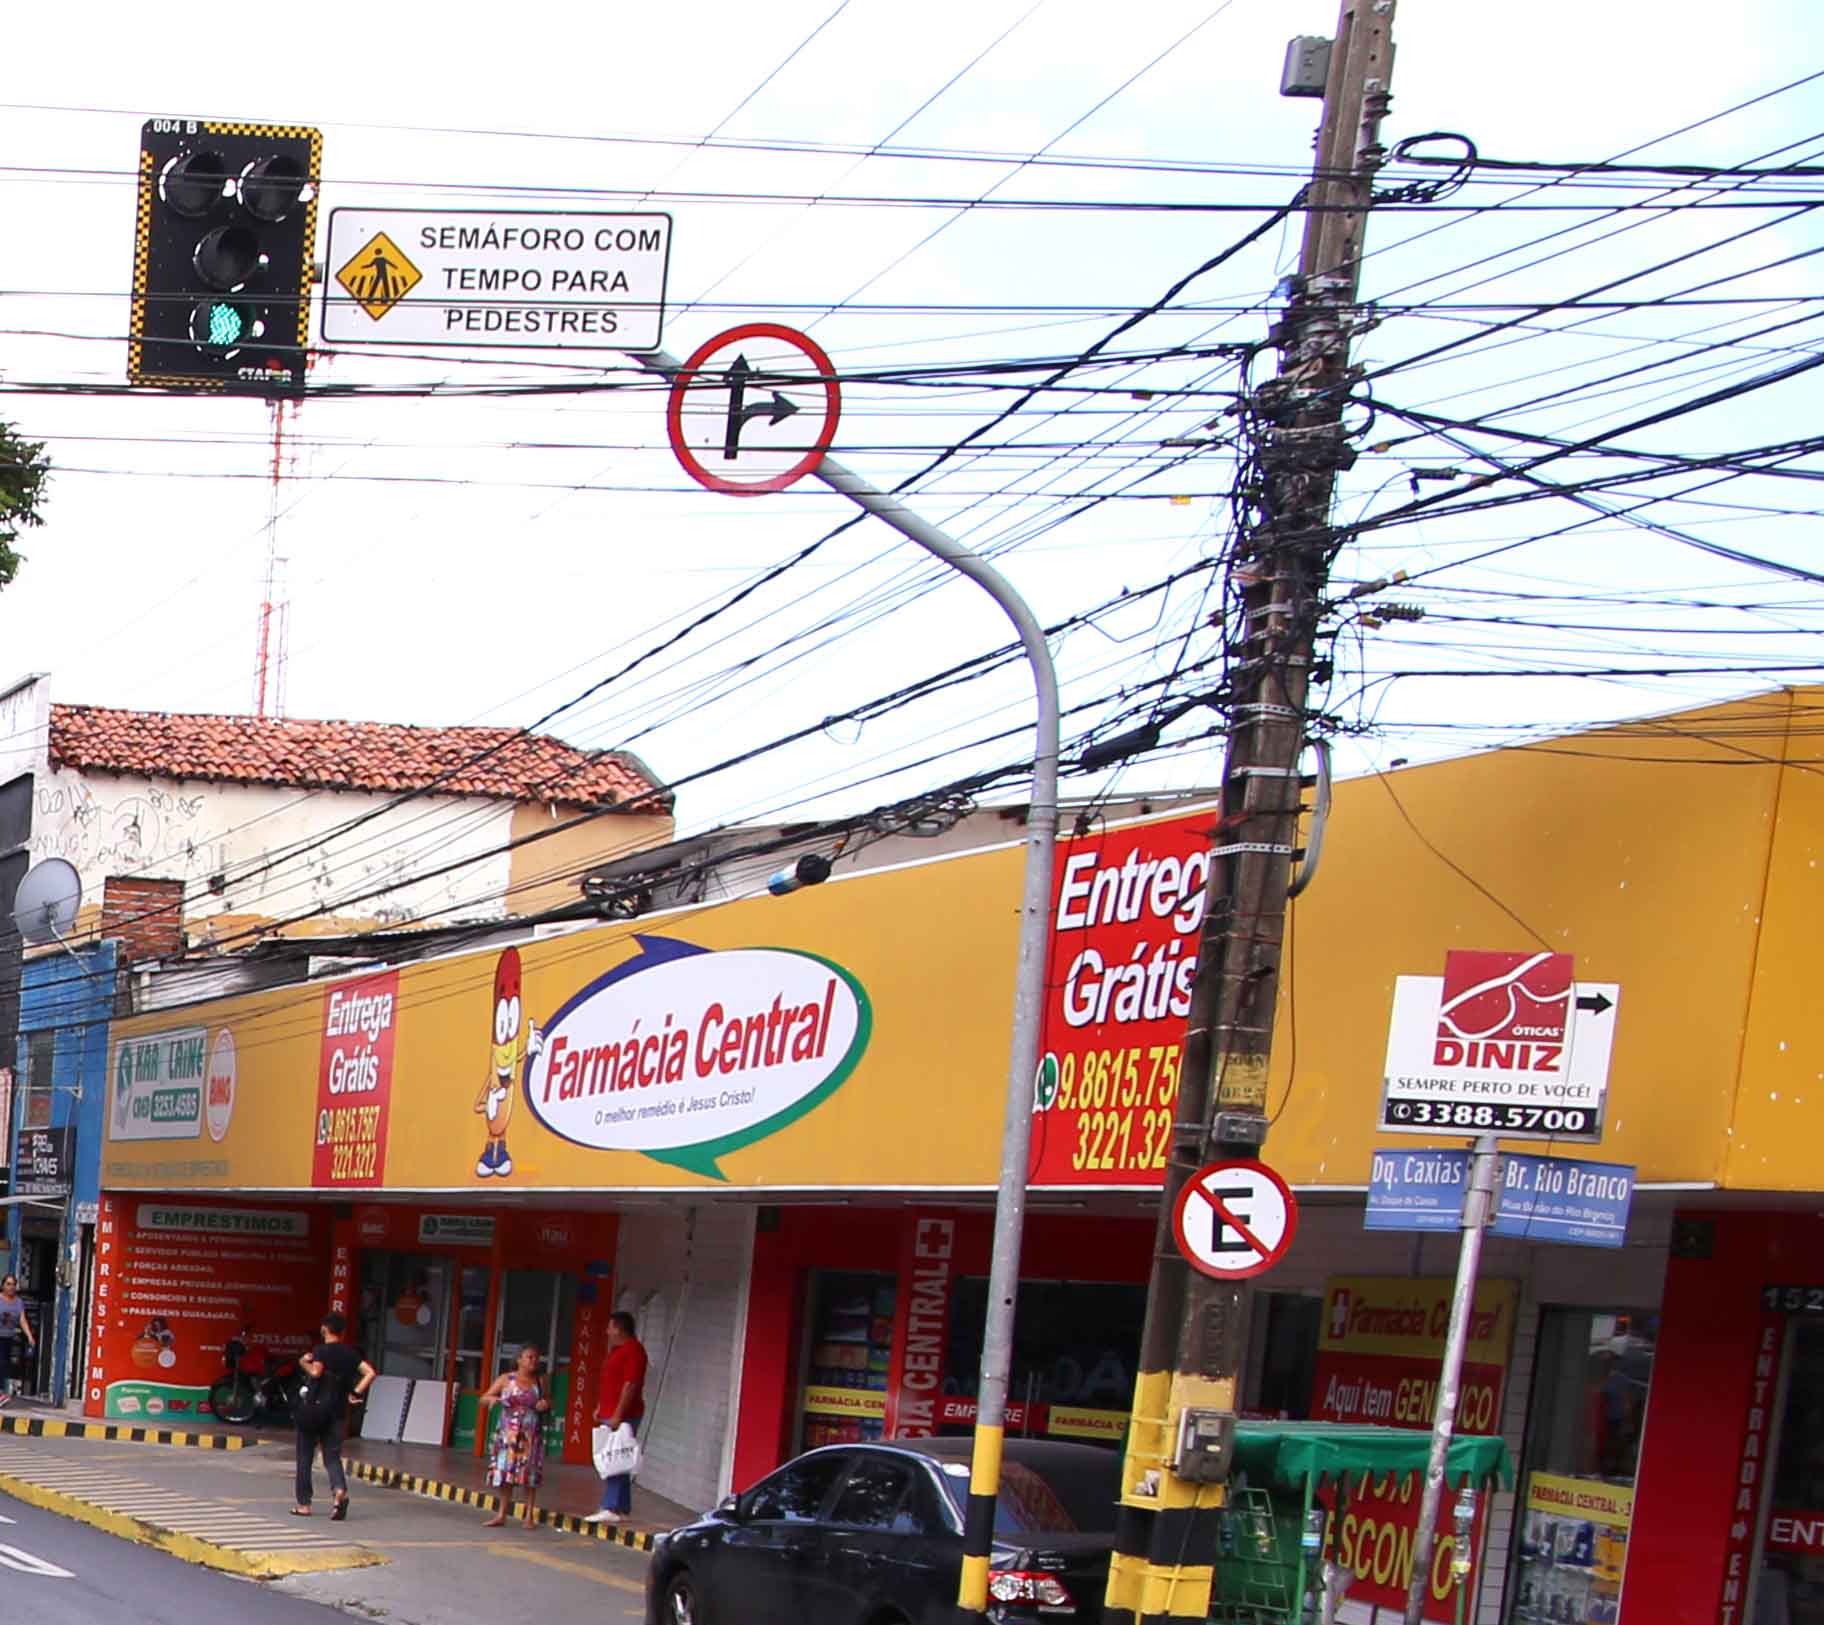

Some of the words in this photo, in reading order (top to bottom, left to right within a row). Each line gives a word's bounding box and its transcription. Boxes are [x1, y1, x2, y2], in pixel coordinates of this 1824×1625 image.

[153, 119, 181, 134] 004
[186, 121, 198, 135] B
[420, 222, 584, 252] SEMÁFORO
[594, 228, 662, 252] COM
[442, 267, 542, 292] TEMPO
[551, 269, 630, 293] PARA
[444, 308, 618, 334] PEDESTRES
[1055, 848, 1212, 934] Entreg
[1063, 939, 1197, 1028] Grátis
[326, 990, 393, 1043] Entrega
[542, 1012, 689, 1105] Farmácia
[694, 977, 838, 1080] Central
[1511, 1023, 1560, 1038] ÓTICAS
[328, 1045, 380, 1095] Grátis
[1432, 1040, 1565, 1072] DINIZ
[594, 1109, 603, 1126] O
[604, 1102, 637, 1124] melhor
[637, 1098, 677, 1120] remédio
[678, 1099, 685, 1114] é
[686, 1094, 717, 1113] Jesus
[719, 1087, 757, 1110] Cristo!
[1397, 1077, 1457, 1093] SEMPRE
[1462, 1079, 1513, 1095] PERTO
[1517, 1082, 1538, 1096] DE
[1072, 1109, 1173, 1171] 3221.32
[1413, 1102, 1586, 1131] 3388.5700
[1371, 1156, 1399, 1190] Dq.
[1403, 1153, 1462, 1185] Caxias
[1505, 1160, 1530, 1190] Br.
[1534, 1163, 1562, 1194] Rio
[1566, 1168, 1629, 1201] Branco
[1212, 1185, 1254, 1254] E
[903, 1262, 950, 1396] CENTRAL
[569, 1309, 593, 1445] UANABARA
[1323, 1374, 1363, 1421] Aqui
[1361, 1380, 1394, 1418] tem
[1393, 1377, 1494, 1431] GENICO
[1736, 1326, 1777, 1513] ENTRADA
[1322, 1509, 1456, 1601] ESCONO
